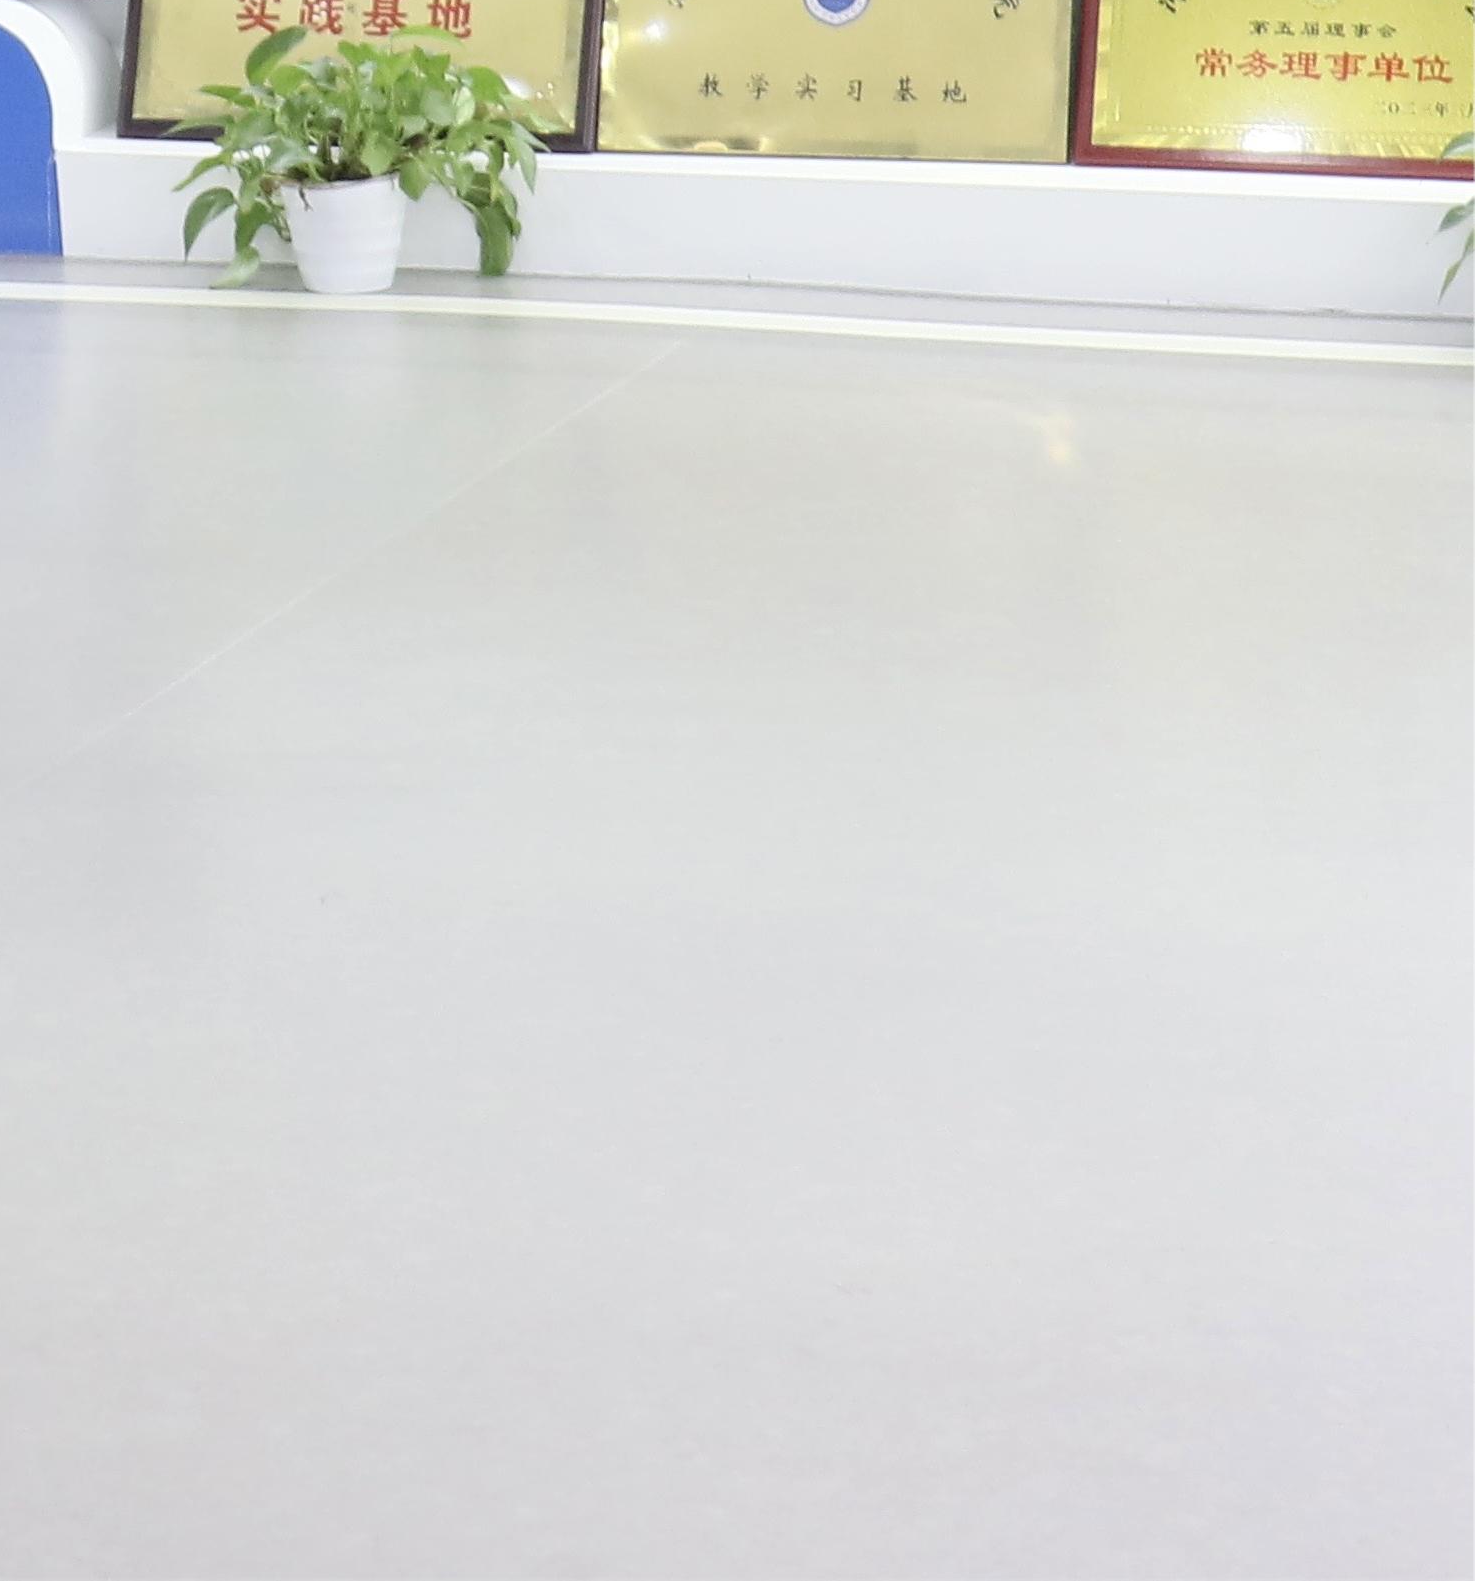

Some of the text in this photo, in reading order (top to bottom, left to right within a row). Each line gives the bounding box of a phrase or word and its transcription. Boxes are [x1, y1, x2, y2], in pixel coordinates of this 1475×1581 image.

[1249, 19, 1399, 40] 第五届理事会
[1195, 47, 1455, 85] 常务理事单位
[699, 72, 968, 104] 教学实习基地
